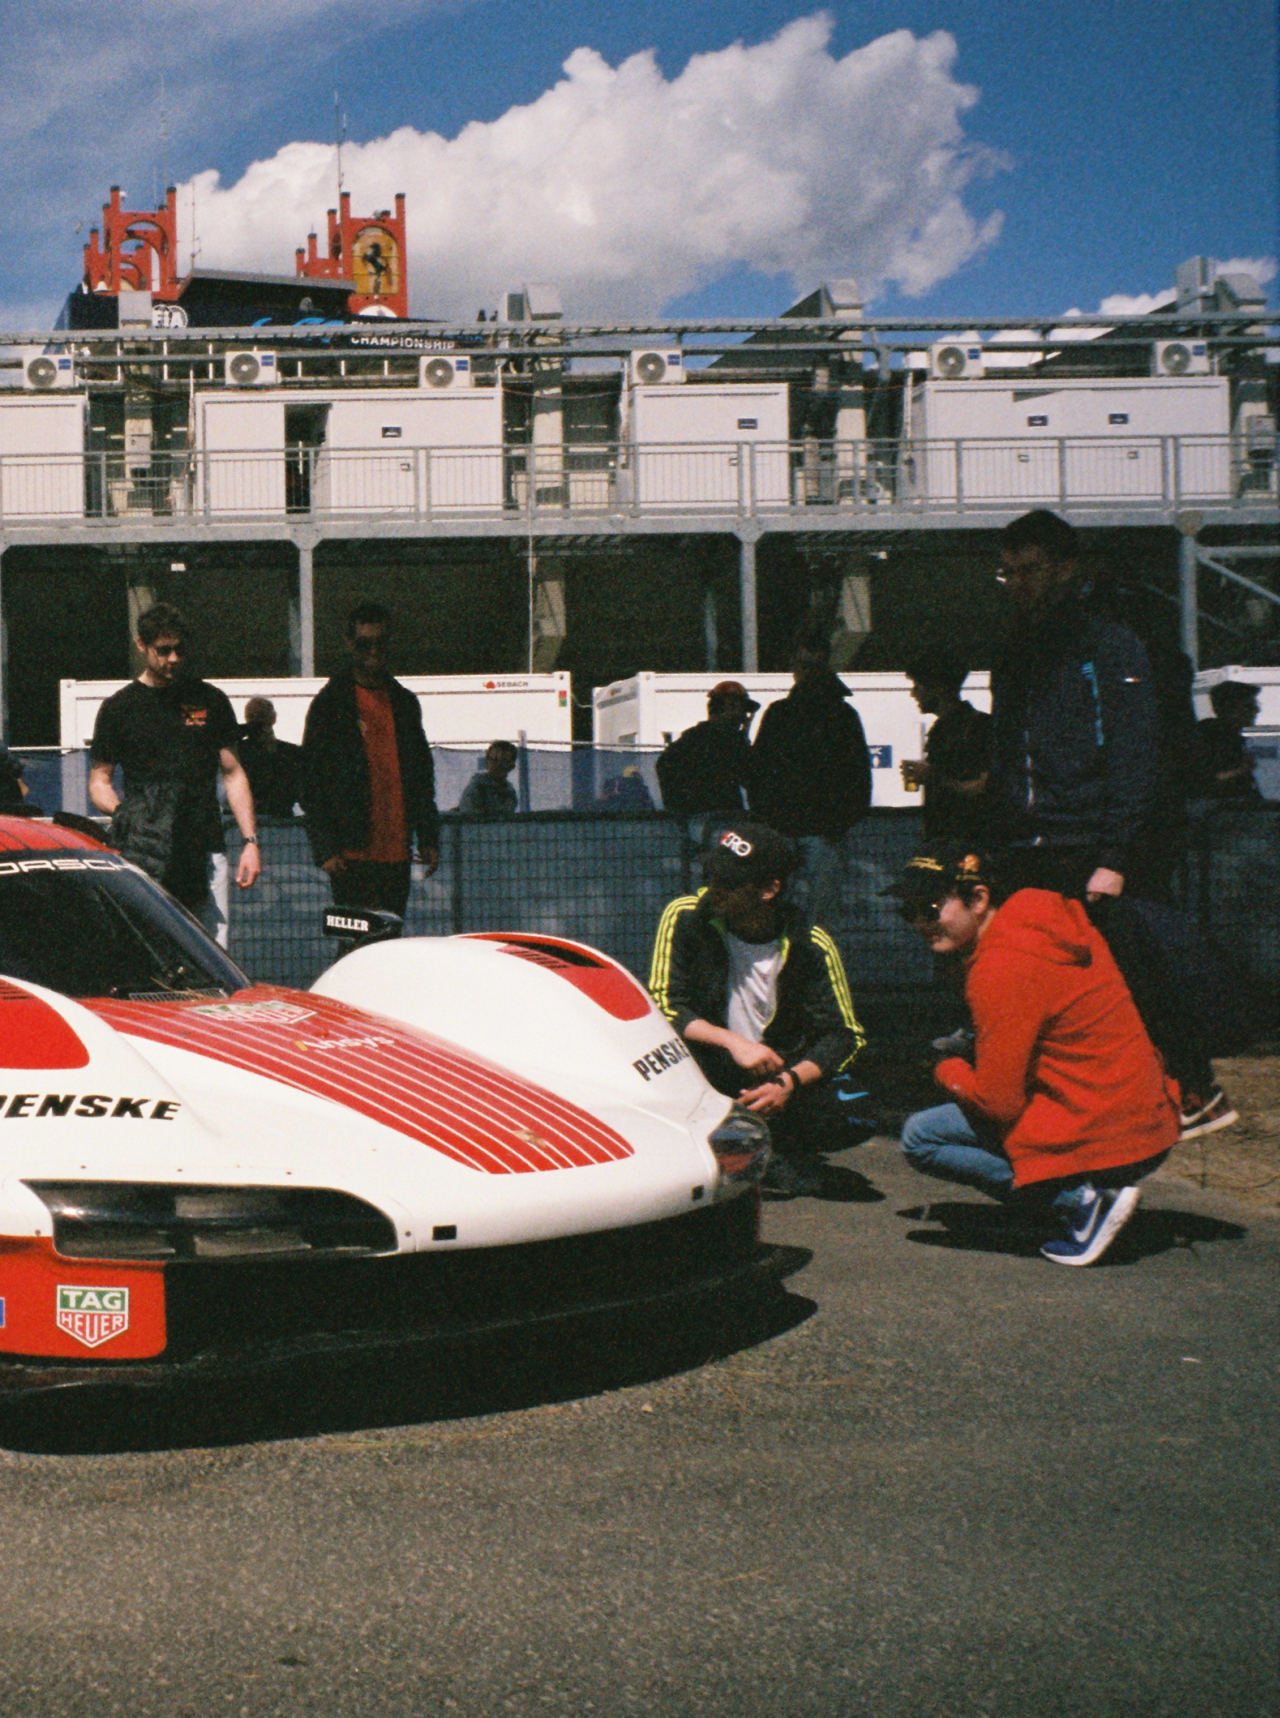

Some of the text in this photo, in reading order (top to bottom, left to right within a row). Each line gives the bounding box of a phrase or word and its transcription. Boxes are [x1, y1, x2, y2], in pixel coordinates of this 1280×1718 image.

[351, 336, 455, 349] CHAMPIONSHIP
[326, 914, 369, 932] HELLER
[63, 1290, 122, 1310] TAG
[61, 1312, 124, 1343] HEUER
